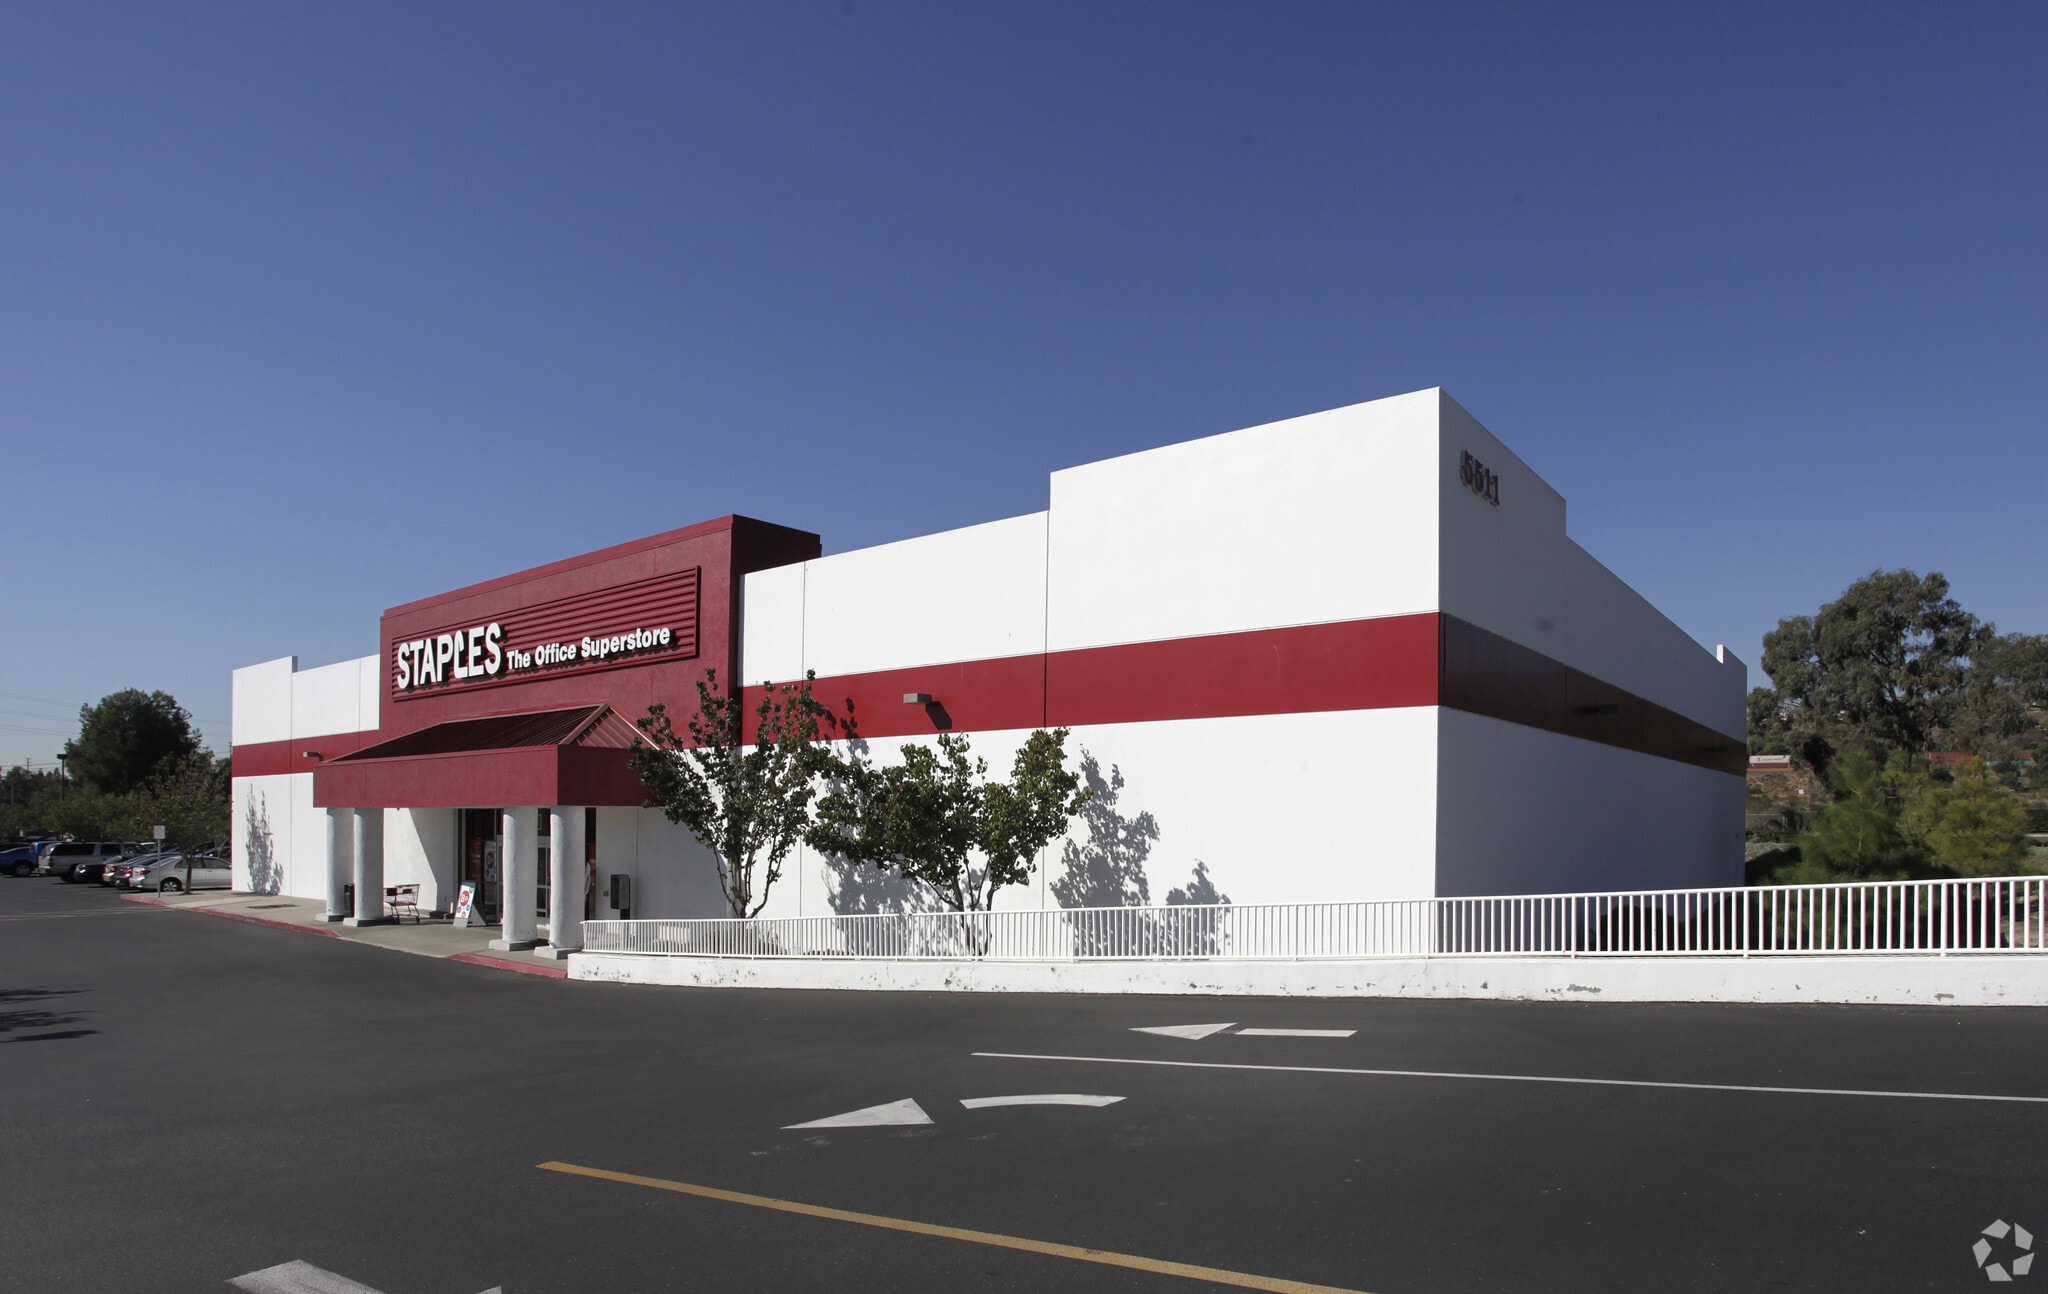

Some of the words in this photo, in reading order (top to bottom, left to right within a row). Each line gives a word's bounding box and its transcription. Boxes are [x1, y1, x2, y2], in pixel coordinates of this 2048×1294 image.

[398, 623, 501, 689] STAPLES
[507, 651, 530, 669] The
[535, 643, 576, 665] Office
[582, 628, 670, 658] Superstore
